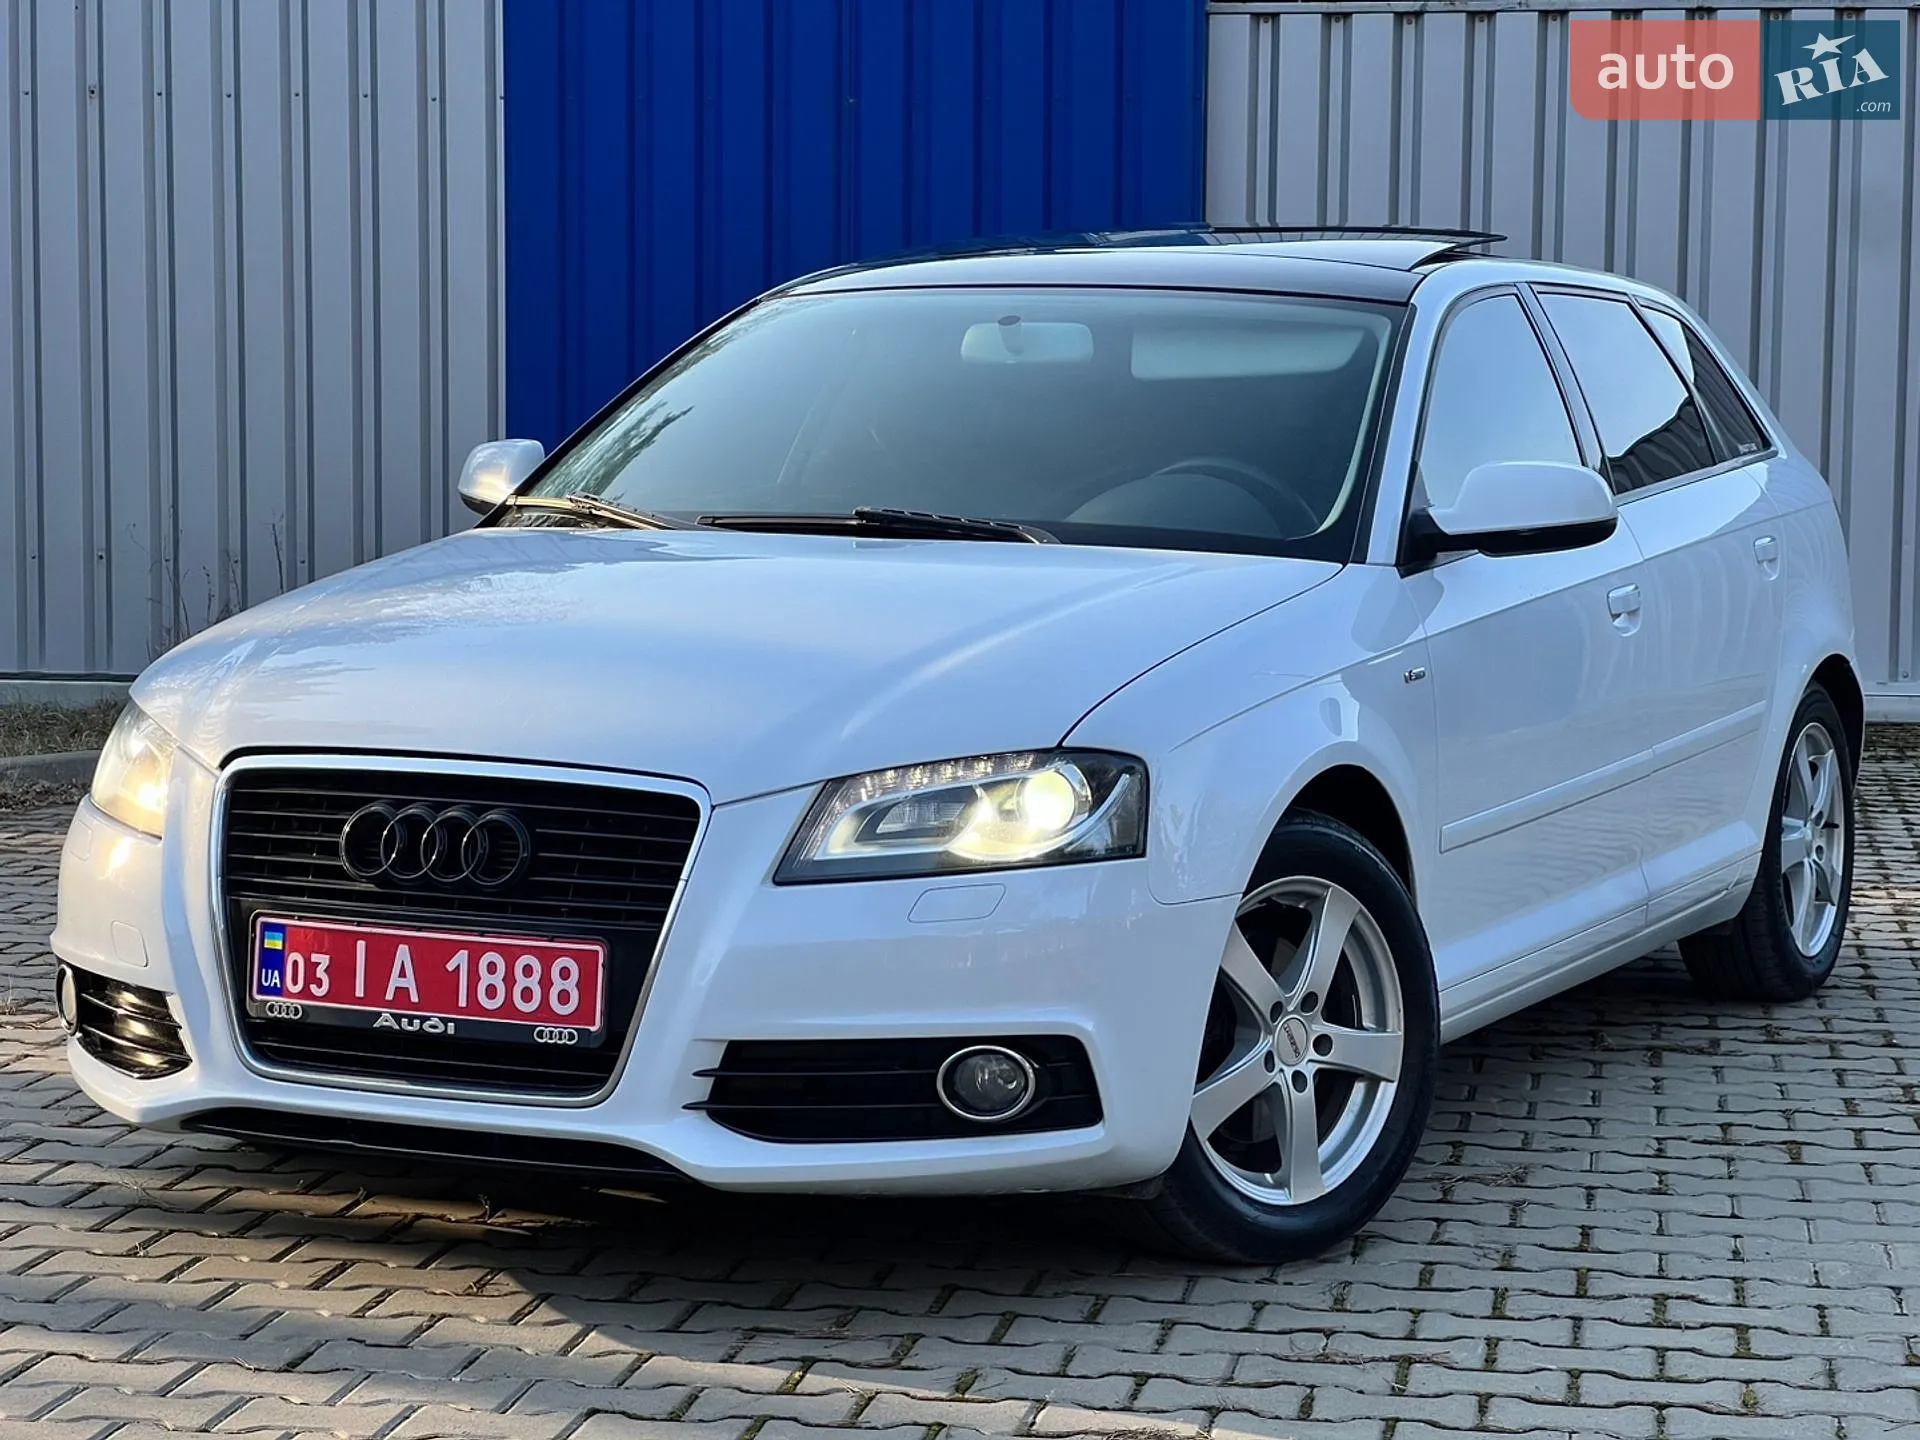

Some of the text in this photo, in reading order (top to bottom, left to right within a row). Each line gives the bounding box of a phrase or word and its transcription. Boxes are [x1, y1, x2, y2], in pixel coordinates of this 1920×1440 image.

[261, 967, 282, 989] UA
[285, 952, 331, 997] 03
[445, 949, 580, 1016] 1888
[372, 1012, 456, 1036] Audi
